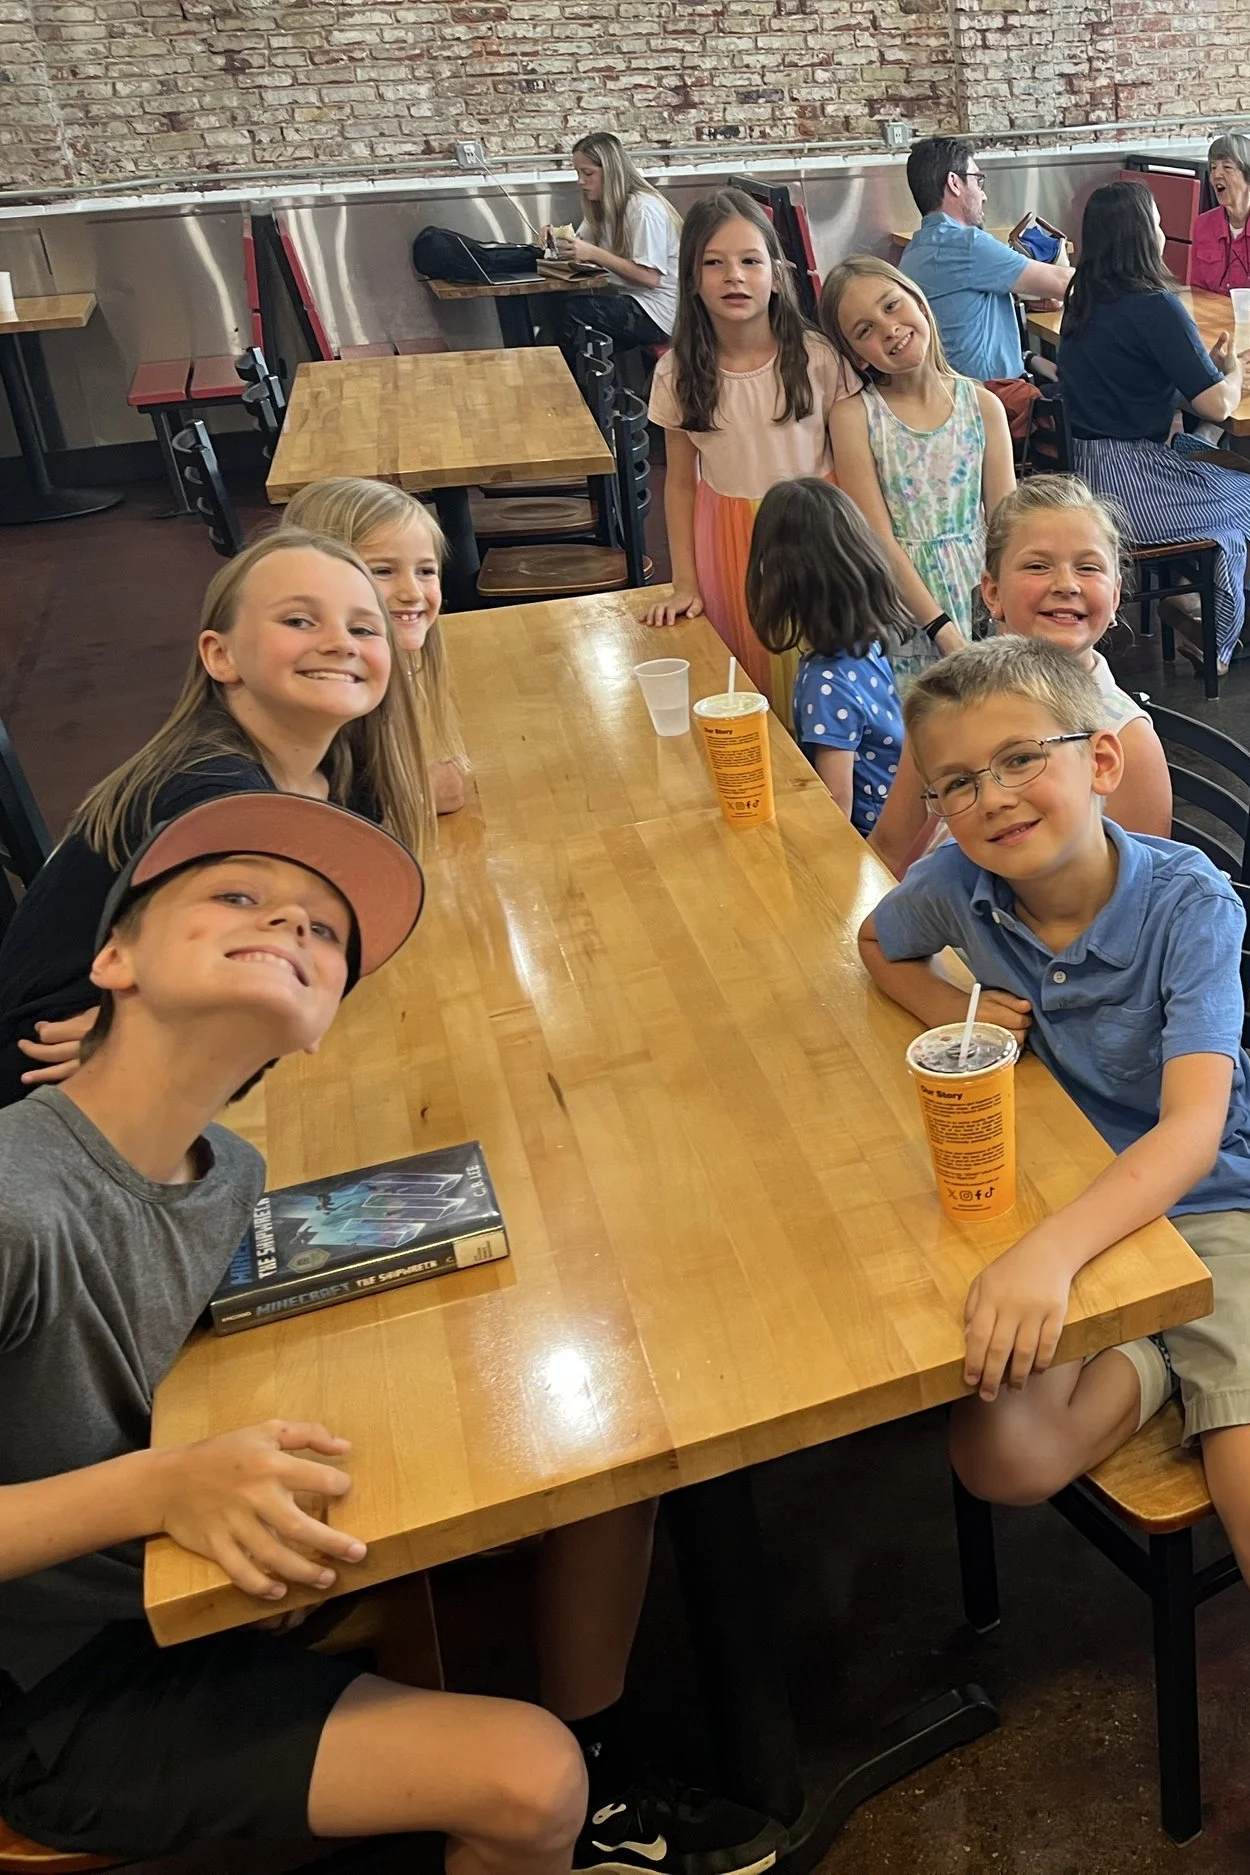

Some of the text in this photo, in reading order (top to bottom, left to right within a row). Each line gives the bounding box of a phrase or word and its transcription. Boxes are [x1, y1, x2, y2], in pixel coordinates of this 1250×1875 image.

[936, 1090, 964, 1101] Story
[258, 1256, 278, 1280] THE
[256, 1282, 351, 1316] MINECRAFT
